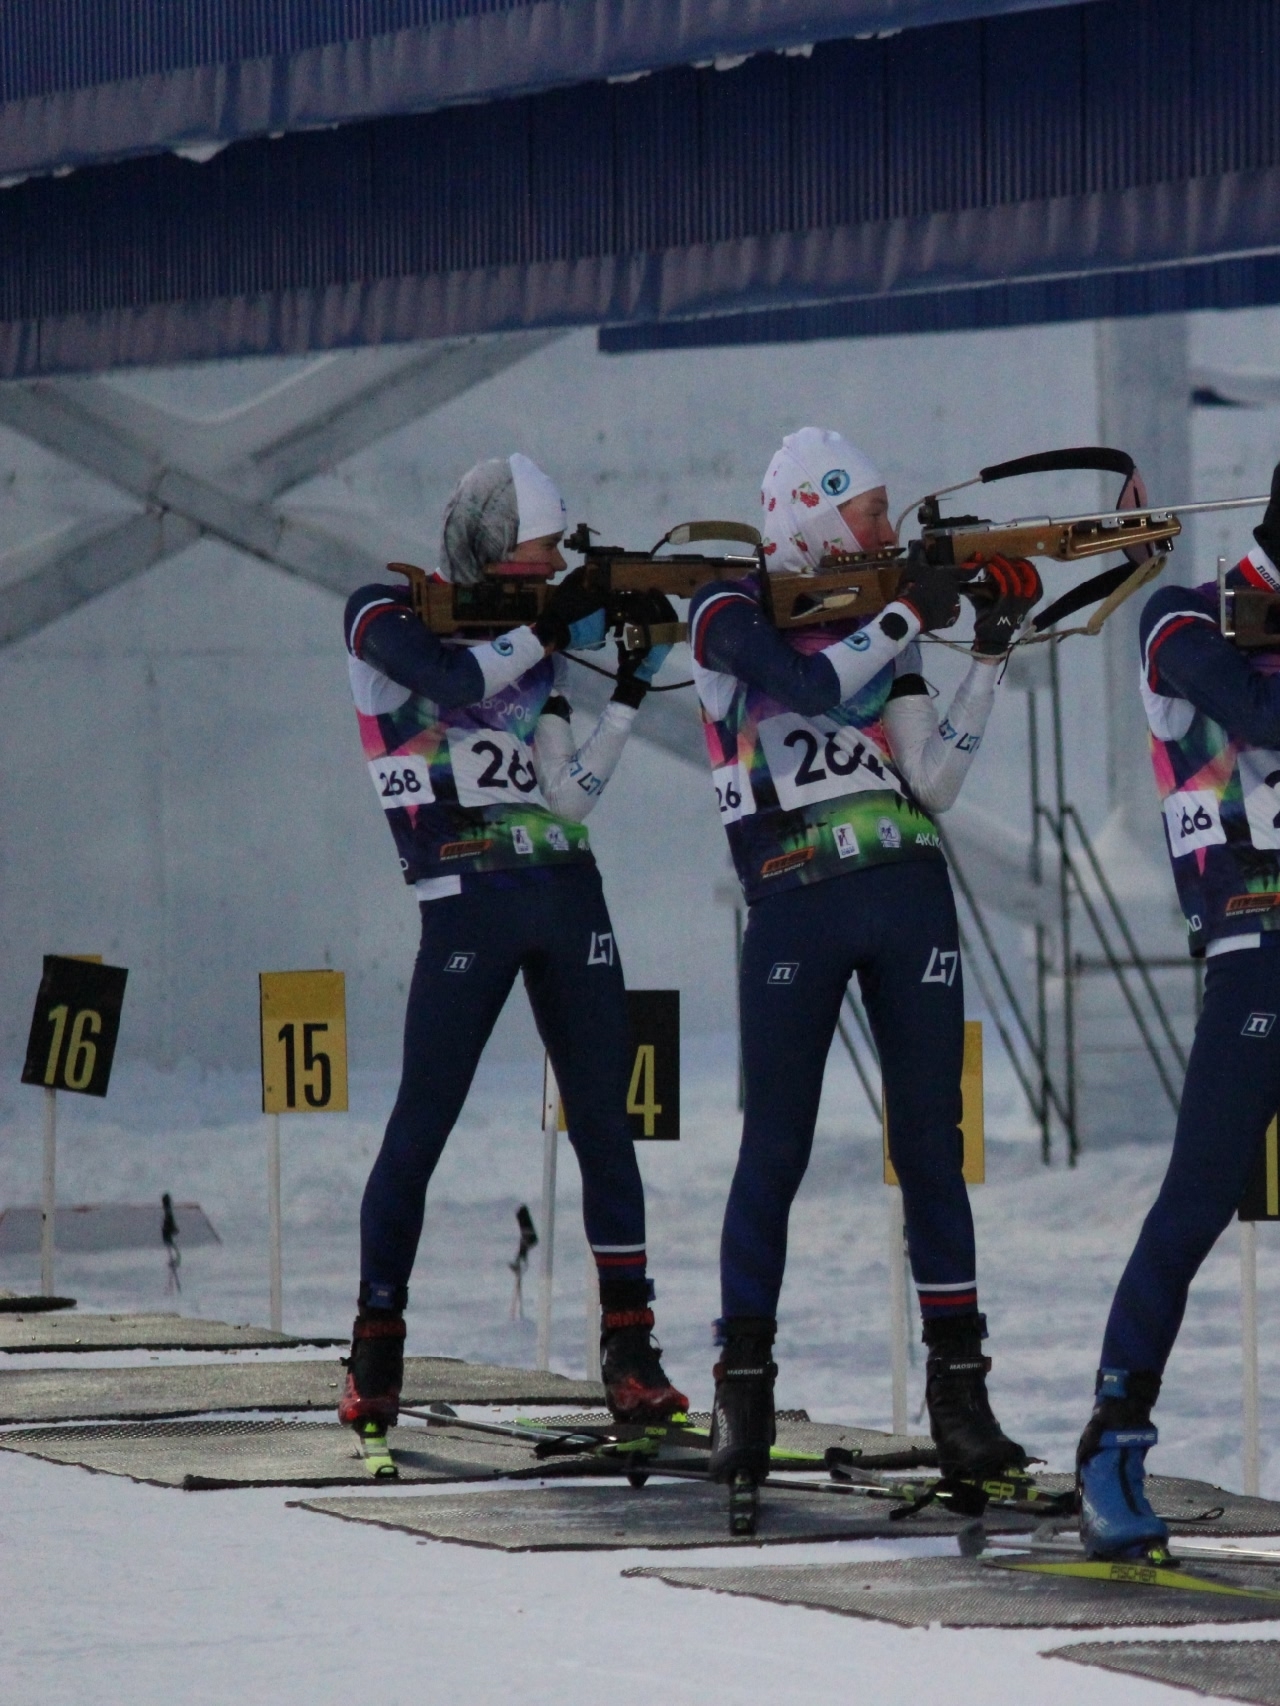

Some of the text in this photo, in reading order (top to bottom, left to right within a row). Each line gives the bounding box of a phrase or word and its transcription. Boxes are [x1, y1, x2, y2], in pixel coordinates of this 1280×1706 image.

[380, 768, 421, 797] 268
[44, 1004, 102, 1091] 16
[277, 1023, 332, 1108] 15
[625, 1044, 663, 1137] 4
[1110, 1564, 1157, 1584] FISCHER
